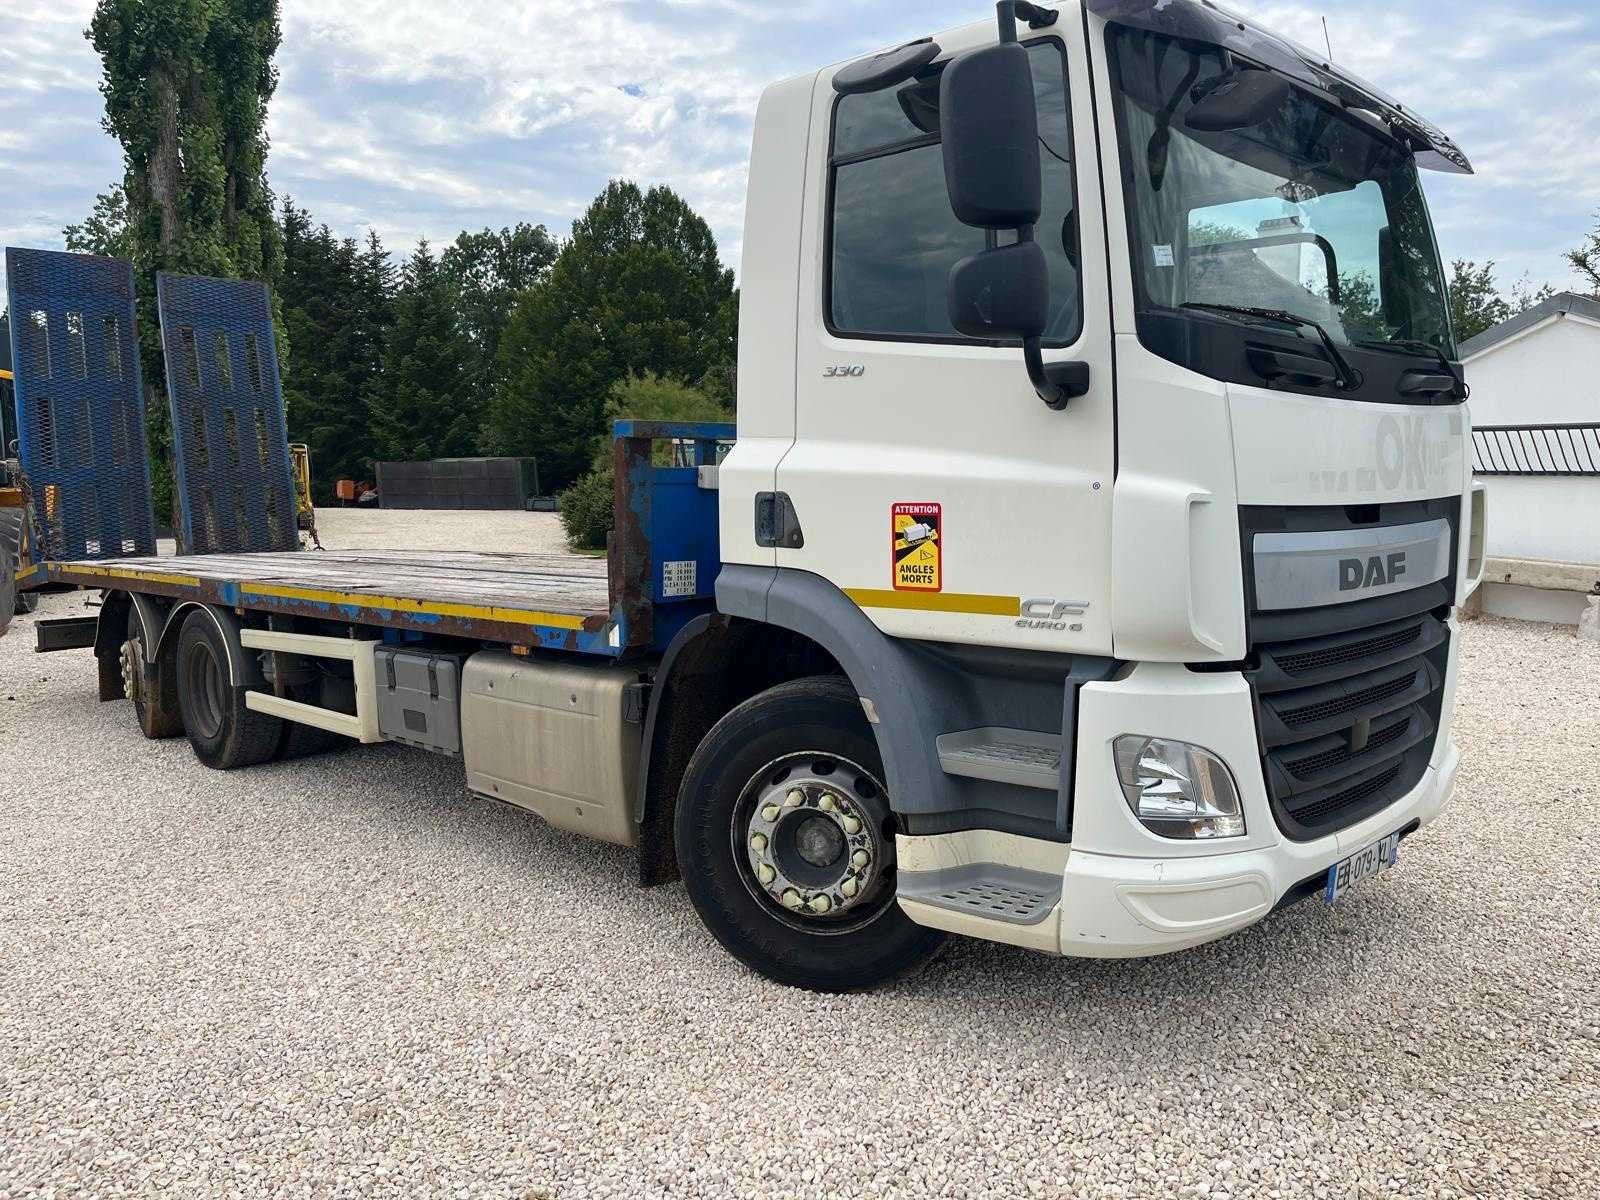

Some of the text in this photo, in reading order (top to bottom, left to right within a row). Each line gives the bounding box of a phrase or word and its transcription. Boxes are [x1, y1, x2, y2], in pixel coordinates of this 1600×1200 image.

[822, 365, 865, 377] 330
[895, 505, 939, 514] ATTENTION
[899, 565, 935, 575] ANGLES
[1338, 551, 1406, 591] DAF
[901, 574, 933, 584] MORTS
[1021, 599, 1090, 620] CF
[1015, 620, 1083, 632] EURO 6
